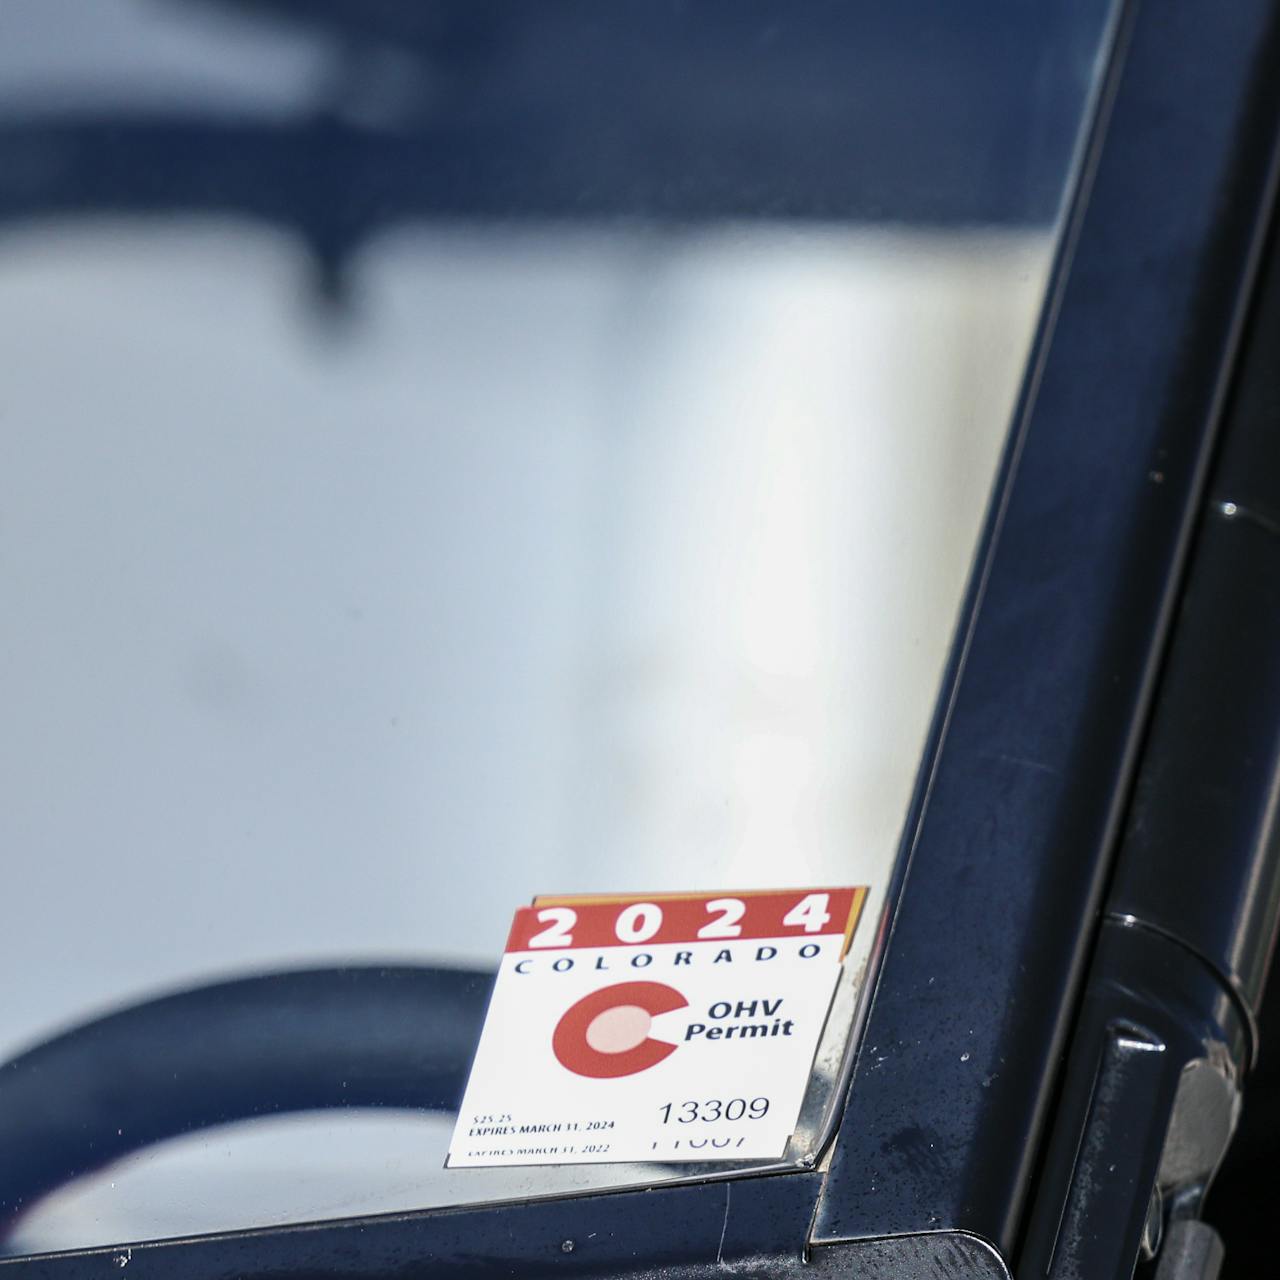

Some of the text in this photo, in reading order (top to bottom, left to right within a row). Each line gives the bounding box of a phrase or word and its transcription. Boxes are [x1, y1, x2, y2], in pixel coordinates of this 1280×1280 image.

[528, 893, 831, 949] 2024
[514, 943, 822, 975] COLORADO
[707, 998, 784, 1020] OHV
[684, 1019, 796, 1042] Permit
[659, 1097, 770, 1125] 13309
[469, 1125, 516, 1137] EXPIRES
[519, 1123, 562, 1135] MARCH
[586, 1120, 616, 1131] 2024
